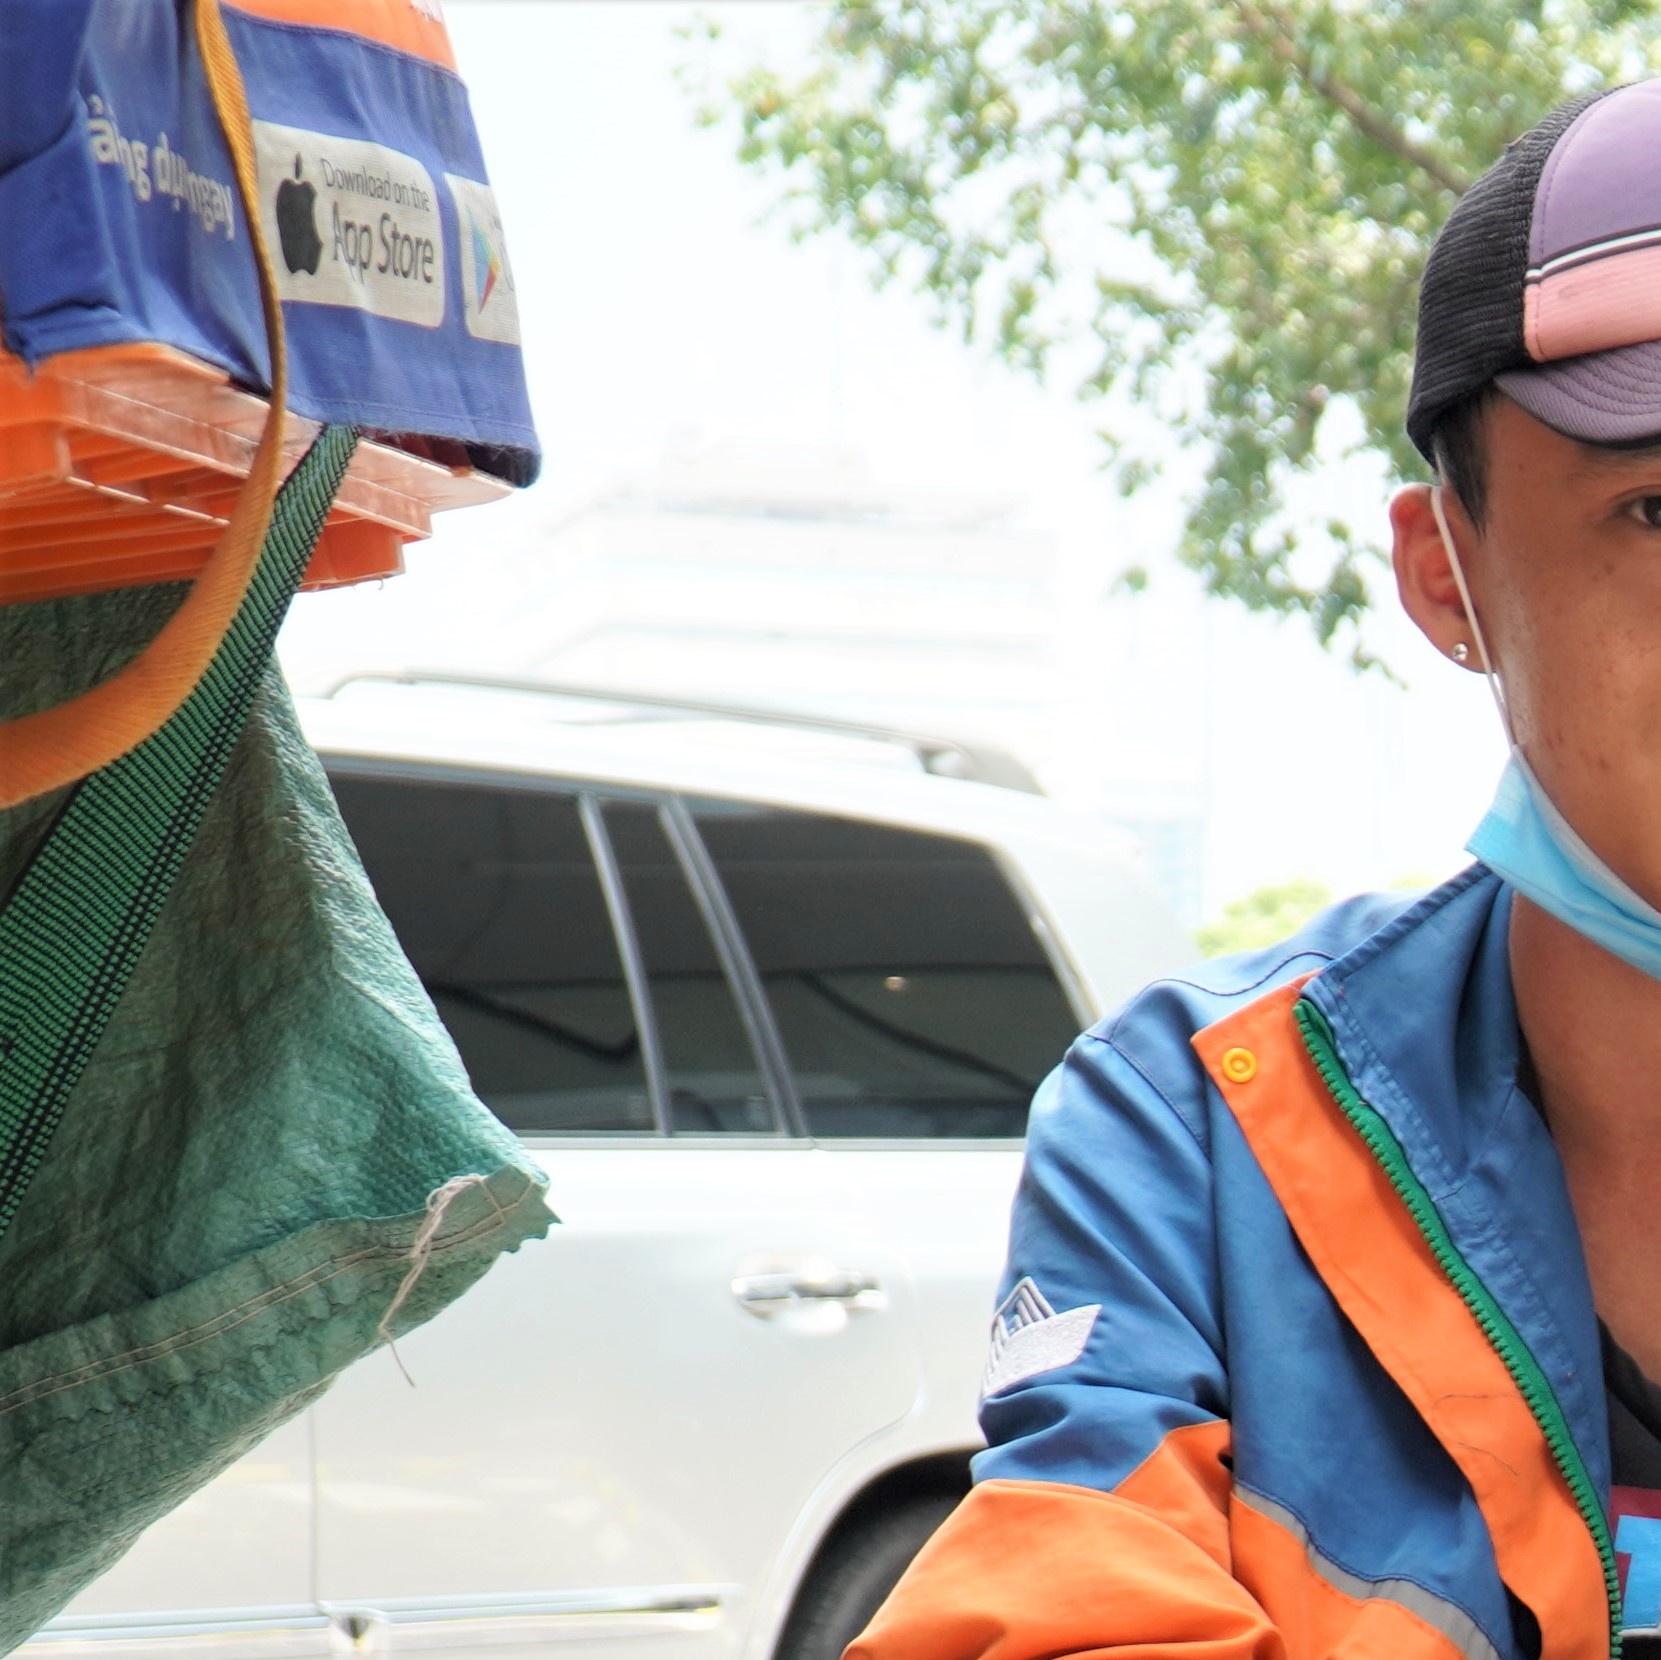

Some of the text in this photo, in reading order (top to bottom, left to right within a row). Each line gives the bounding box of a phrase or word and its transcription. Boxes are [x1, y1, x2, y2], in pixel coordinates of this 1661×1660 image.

[321, 157, 431, 213] Download on the
[331, 202, 374, 284] App
[379, 212, 434, 284] Store
